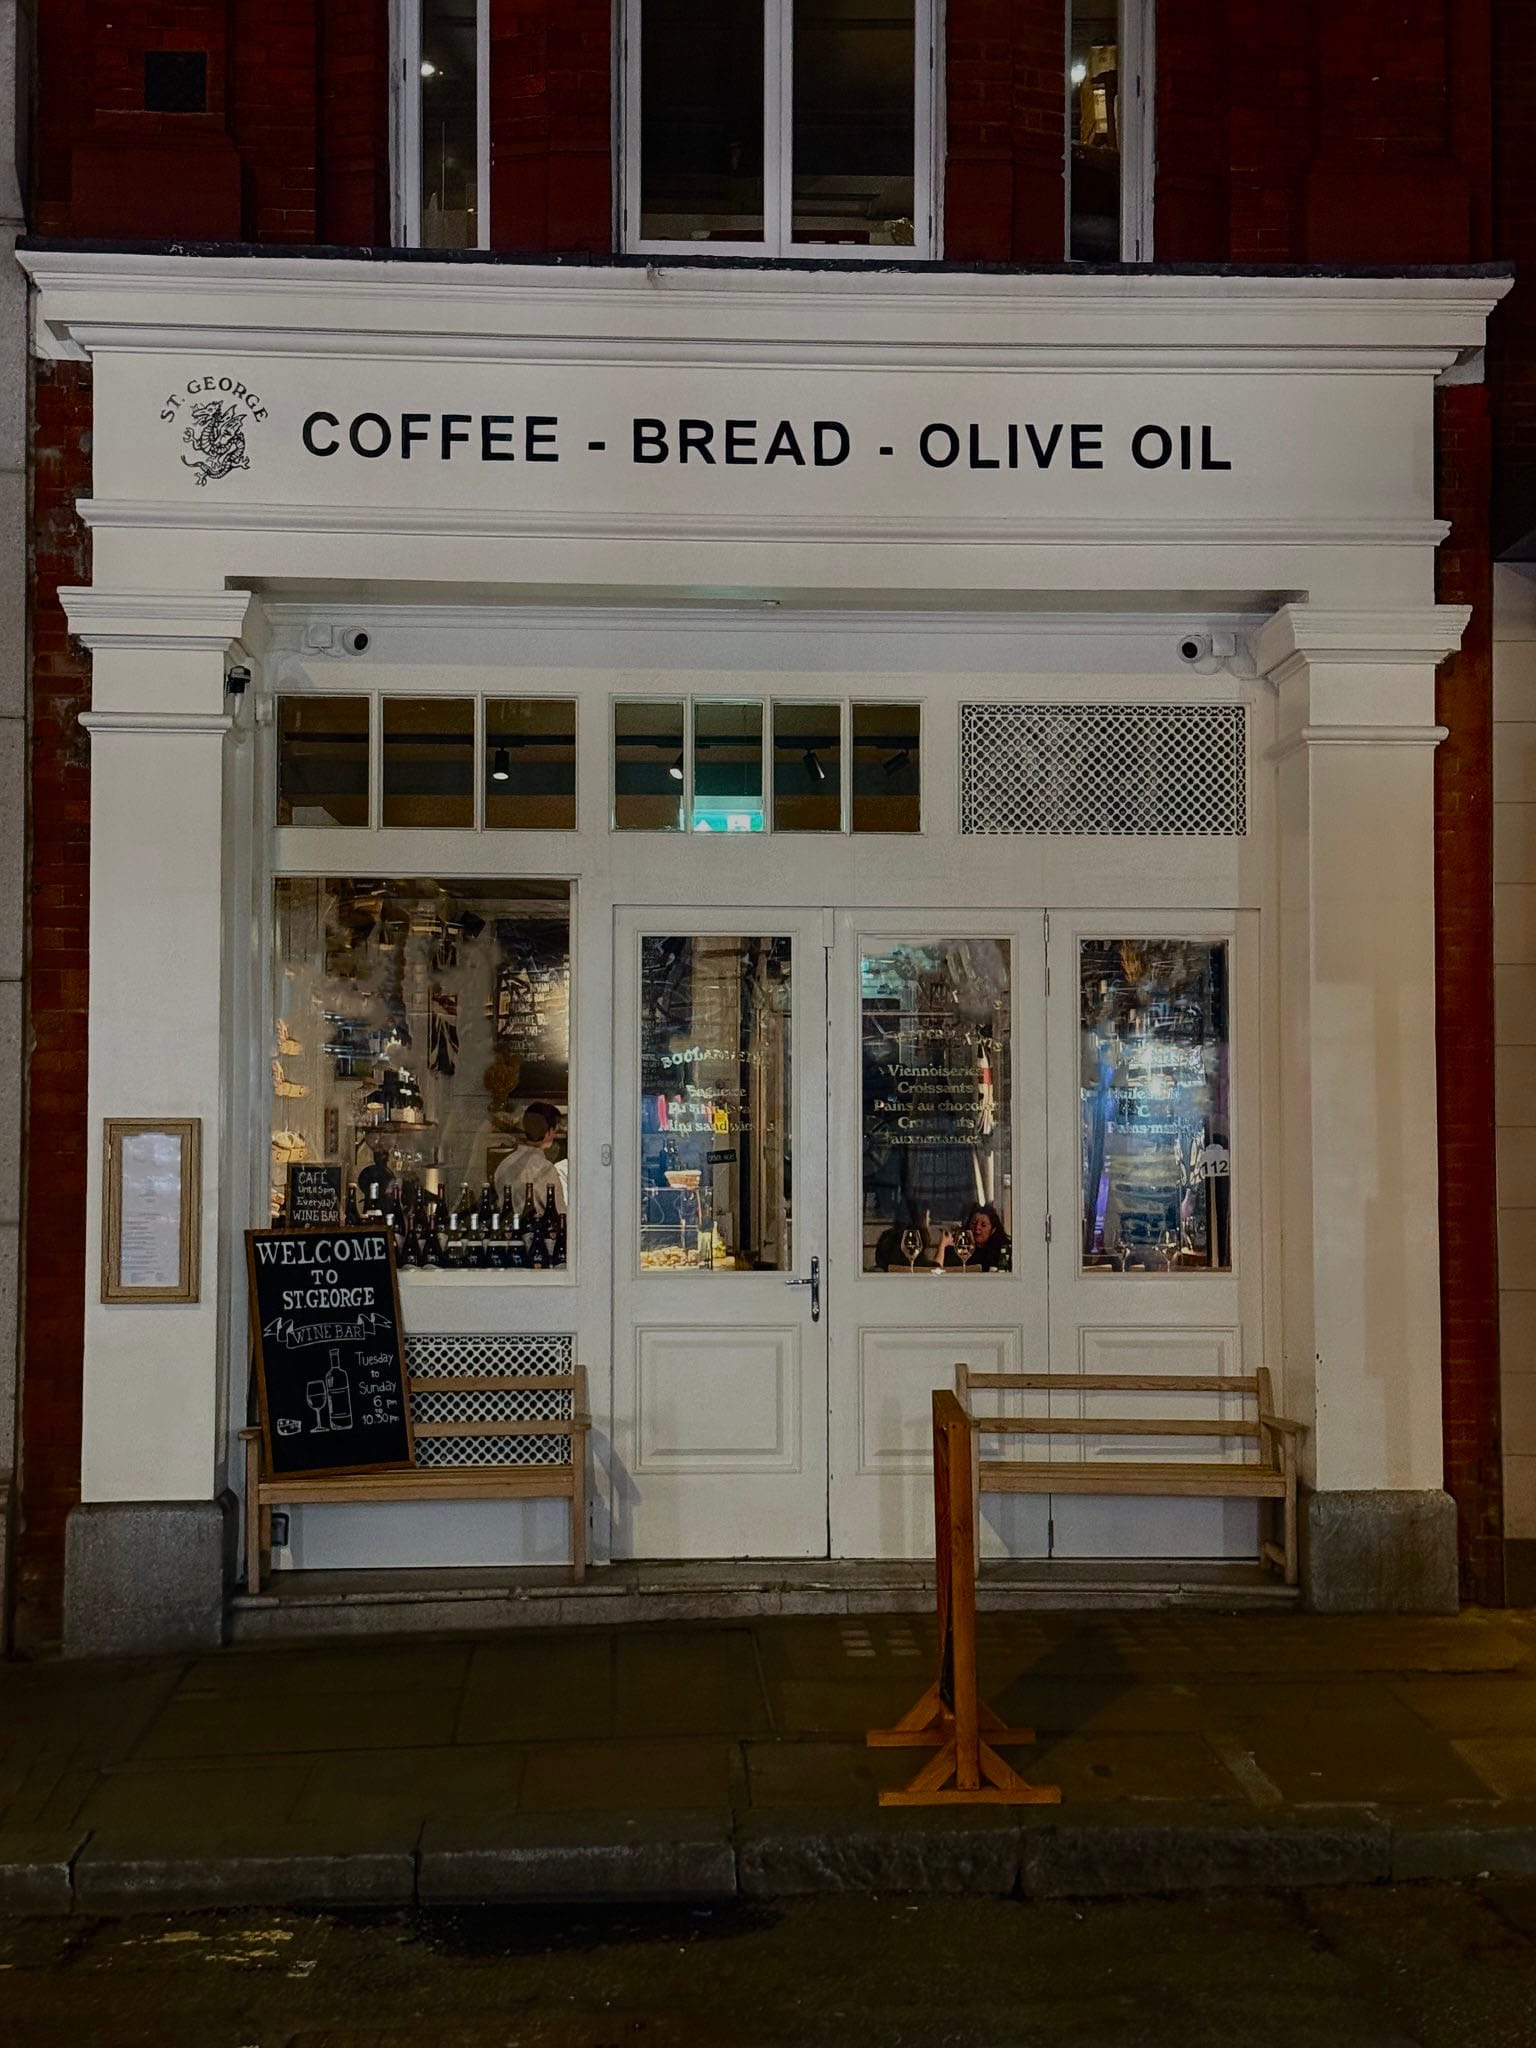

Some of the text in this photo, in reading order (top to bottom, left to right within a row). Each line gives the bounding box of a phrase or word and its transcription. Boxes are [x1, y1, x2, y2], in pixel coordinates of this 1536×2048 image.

[160, 376, 269, 423] ST. GEORGE
[303, 412, 558, 462] COFFEE
[634, 418, 851, 466] BREAD
[920, 423, 1104, 469] OLIVE
[1132, 424, 1232, 470] OIL
[897, 1081, 974, 1094] Croissants
[917, 1102, 934, 1112] au
[1200, 1160, 1229, 1176] 112
[292, 1209, 340, 1222] WINE BAR
[255, 1237, 387, 1265] WELCOME
[310, 1269, 339, 1285] TO
[292, 1324, 363, 1344] WINE BAR
[354, 1351, 394, 1367] Tuesday
[358, 1380, 397, 1395] Sunday
[373, 1395, 382, 1408] 6
